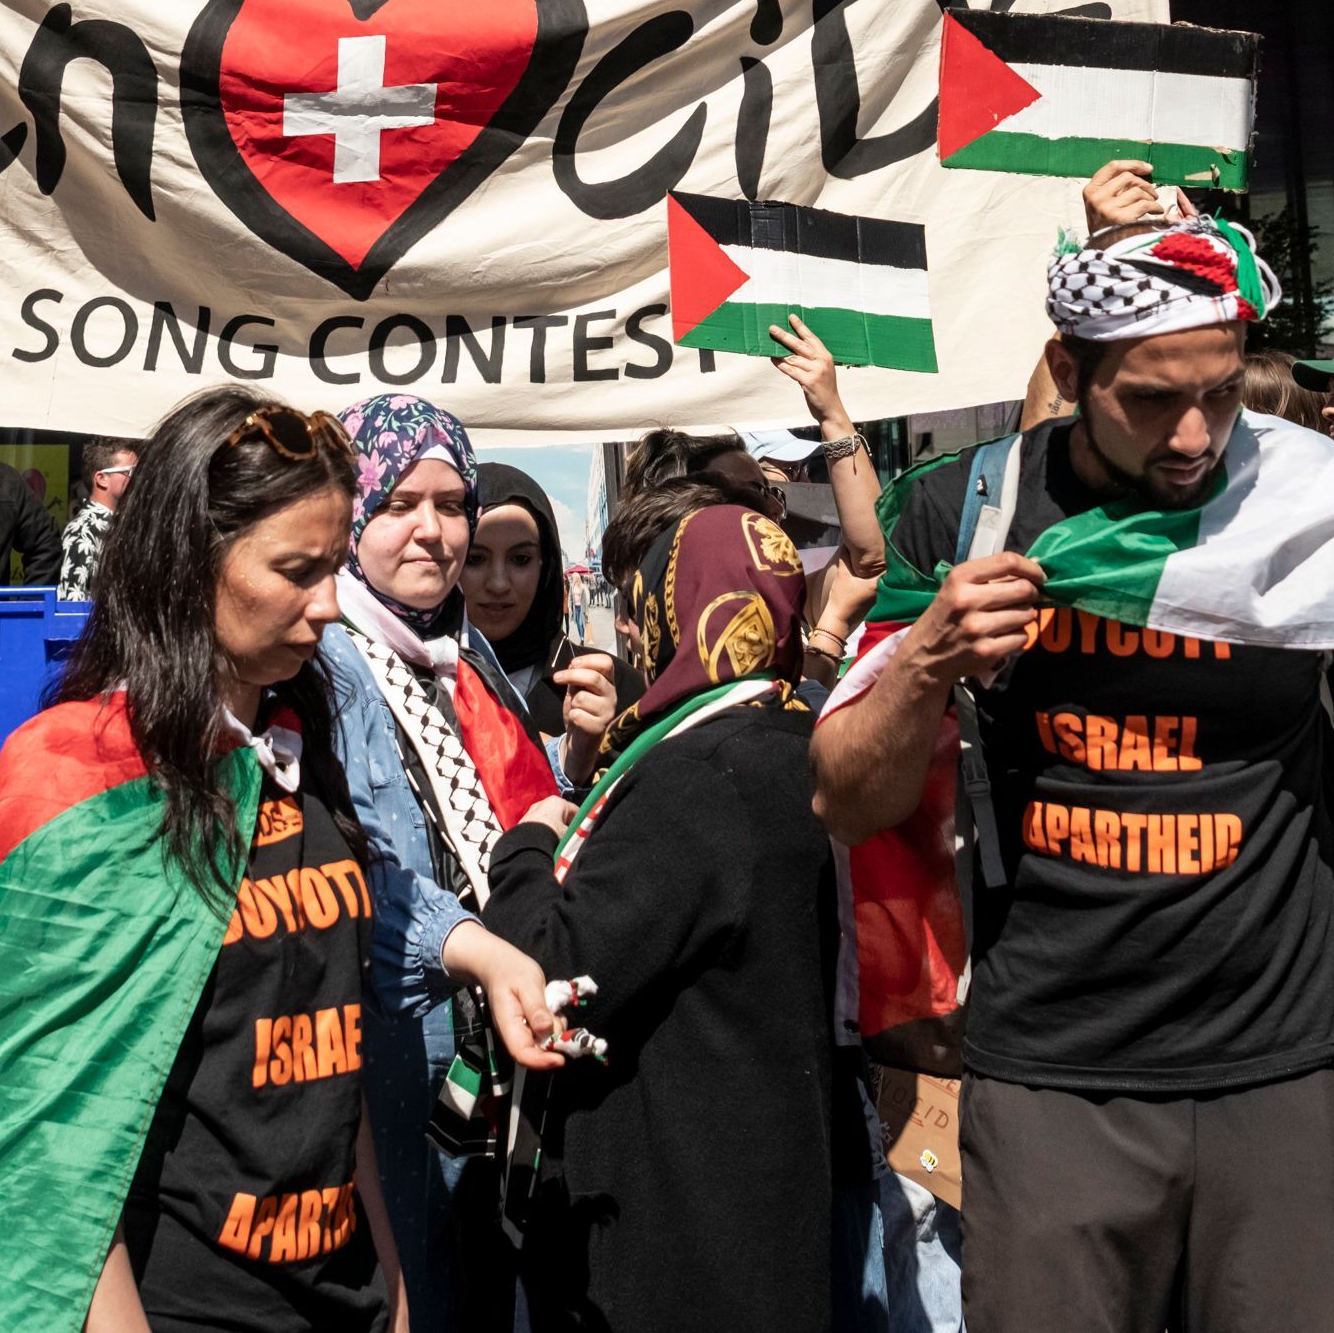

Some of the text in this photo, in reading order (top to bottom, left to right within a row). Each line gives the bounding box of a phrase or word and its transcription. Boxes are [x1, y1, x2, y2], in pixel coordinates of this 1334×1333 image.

[12, 288, 280, 380] SONG
[1036, 711, 1204, 773] ISRAEL
[1023, 800, 1244, 876] APARTHEID
